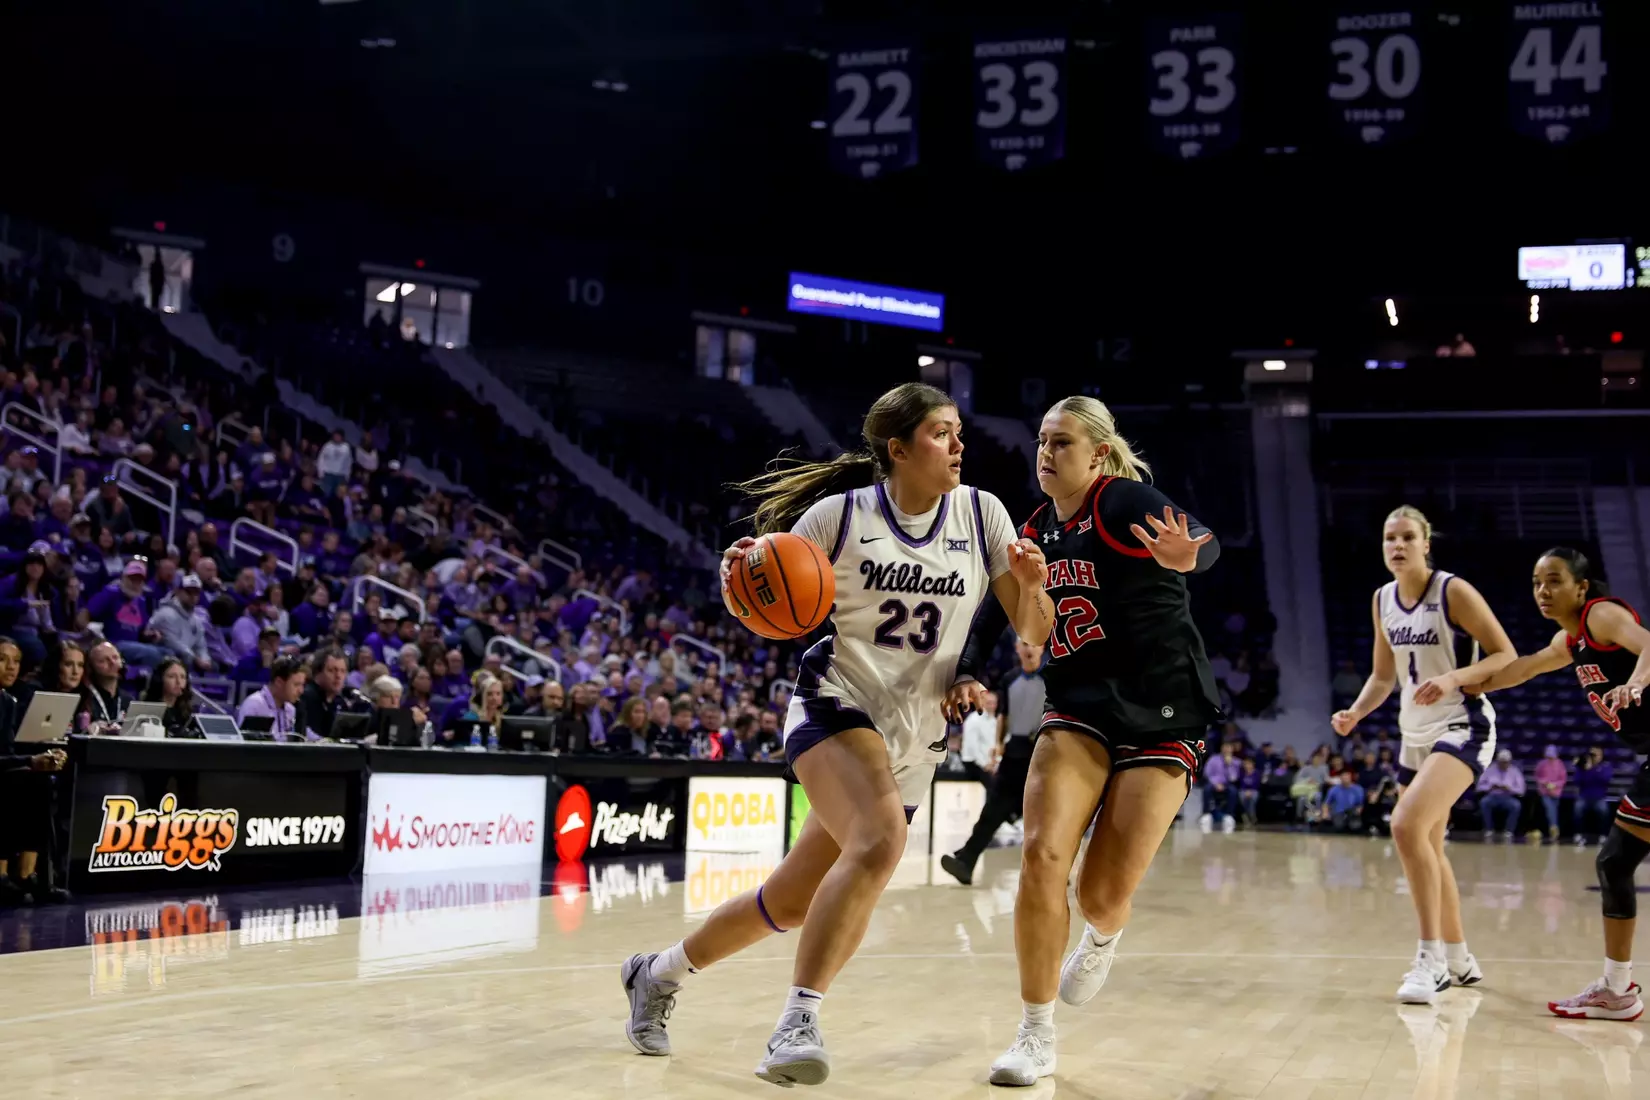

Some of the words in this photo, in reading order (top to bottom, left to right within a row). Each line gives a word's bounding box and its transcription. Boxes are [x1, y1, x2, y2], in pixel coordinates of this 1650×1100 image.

[1336, 11, 1412, 31] BOOZER
[1512, 1, 1603, 20] MURRELL
[1168, 25, 1217, 43] PARR
[1147, 46, 1237, 117] 33
[1327, 33, 1422, 100] 30
[1508, 24, 1608, 97] 44
[831, 70, 912, 138] 22
[976, 61, 1060, 129] 33
[272, 232, 296, 263] 9
[567, 276, 605, 306] 10
[1095, 338, 1133, 361] 12
[746, 548, 778, 608] ELITE
[859, 559, 966, 597] Wildcats
[1044, 559, 1100, 591] TAH
[874, 598, 942, 654] 23
[1388, 626, 1440, 646] Wildcats
[97, 795, 237, 868] Briggs
[245, 817, 301, 847] SINCE
[302, 815, 346, 844] 1979
[590, 801, 641, 848] Pizza
[639, 802, 675, 842] Hut
[693, 791, 777, 840] QDOBA
[93, 851, 164, 867] AUTO.COM
